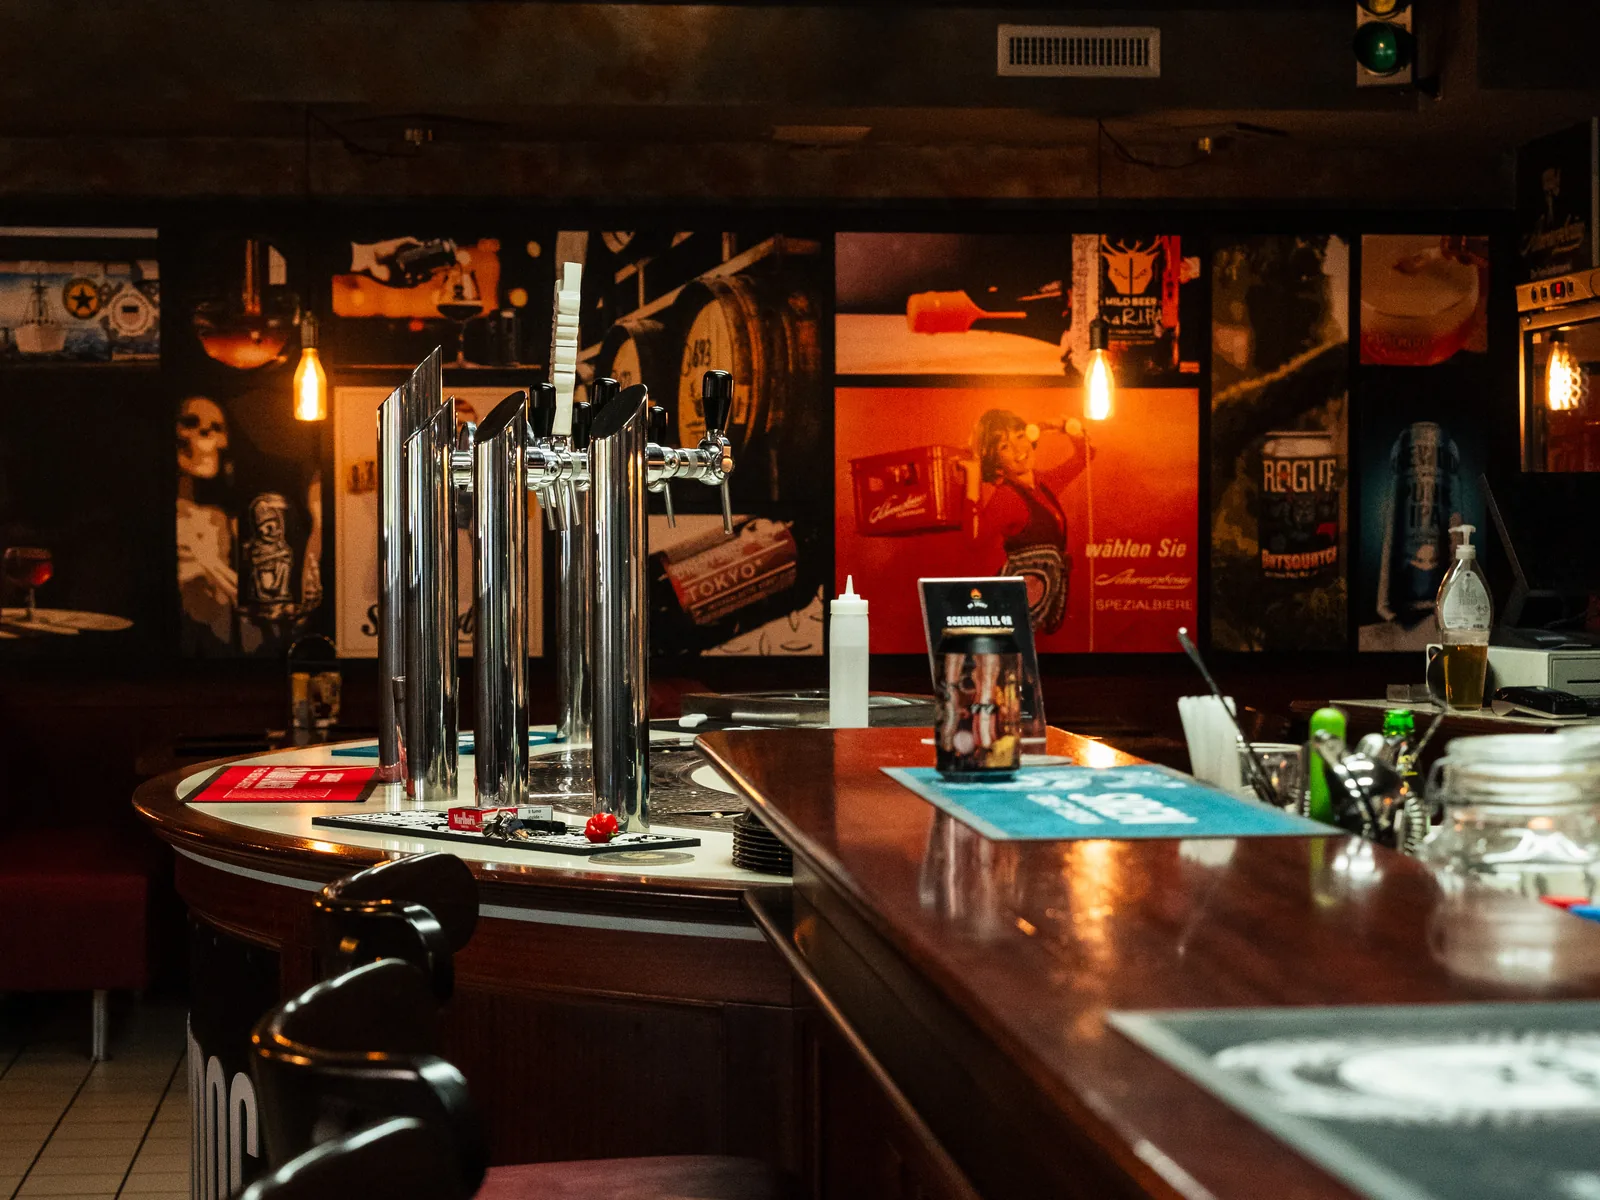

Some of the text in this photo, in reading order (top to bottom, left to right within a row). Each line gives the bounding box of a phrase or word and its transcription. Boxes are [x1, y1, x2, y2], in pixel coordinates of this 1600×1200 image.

[1085, 538, 1187, 558] wählen Sie
[1095, 598, 1193, 611] SPEZIALBIERE
[946, 615, 991, 626] SCANSIONA
[454, 811, 476, 825] Marlboro
